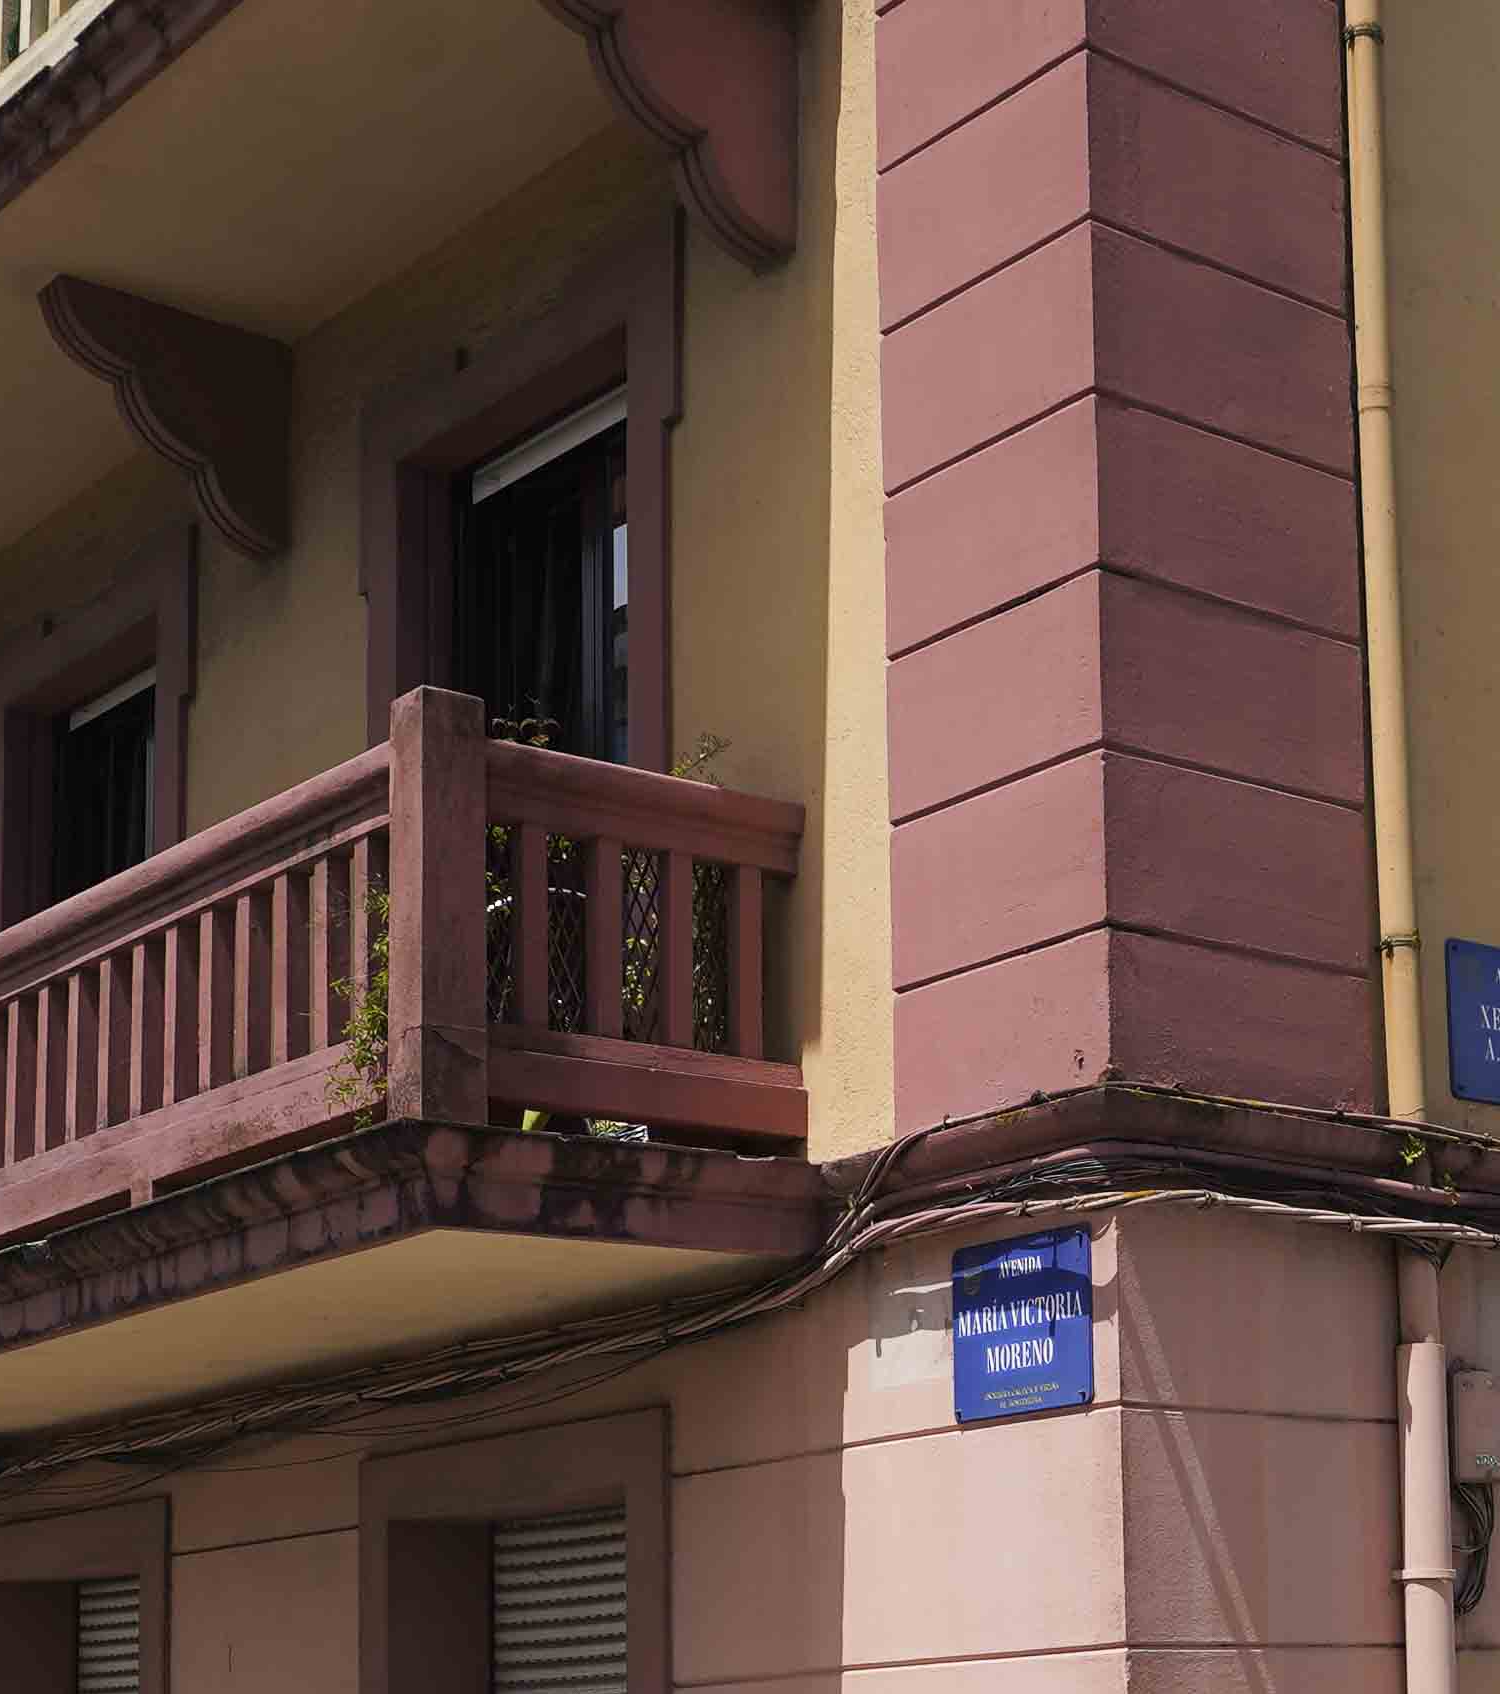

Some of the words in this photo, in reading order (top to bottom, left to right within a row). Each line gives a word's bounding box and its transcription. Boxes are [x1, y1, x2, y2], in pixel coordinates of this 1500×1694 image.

[1485, 1037, 1500, 1062] A.
[999, 1255, 1042, 1279] AVENIDA
[957, 1299, 1008, 1338] MARÍA
[1010, 1289, 1083, 1329] VICTORIA
[986, 1337, 1054, 1374] MORENO
